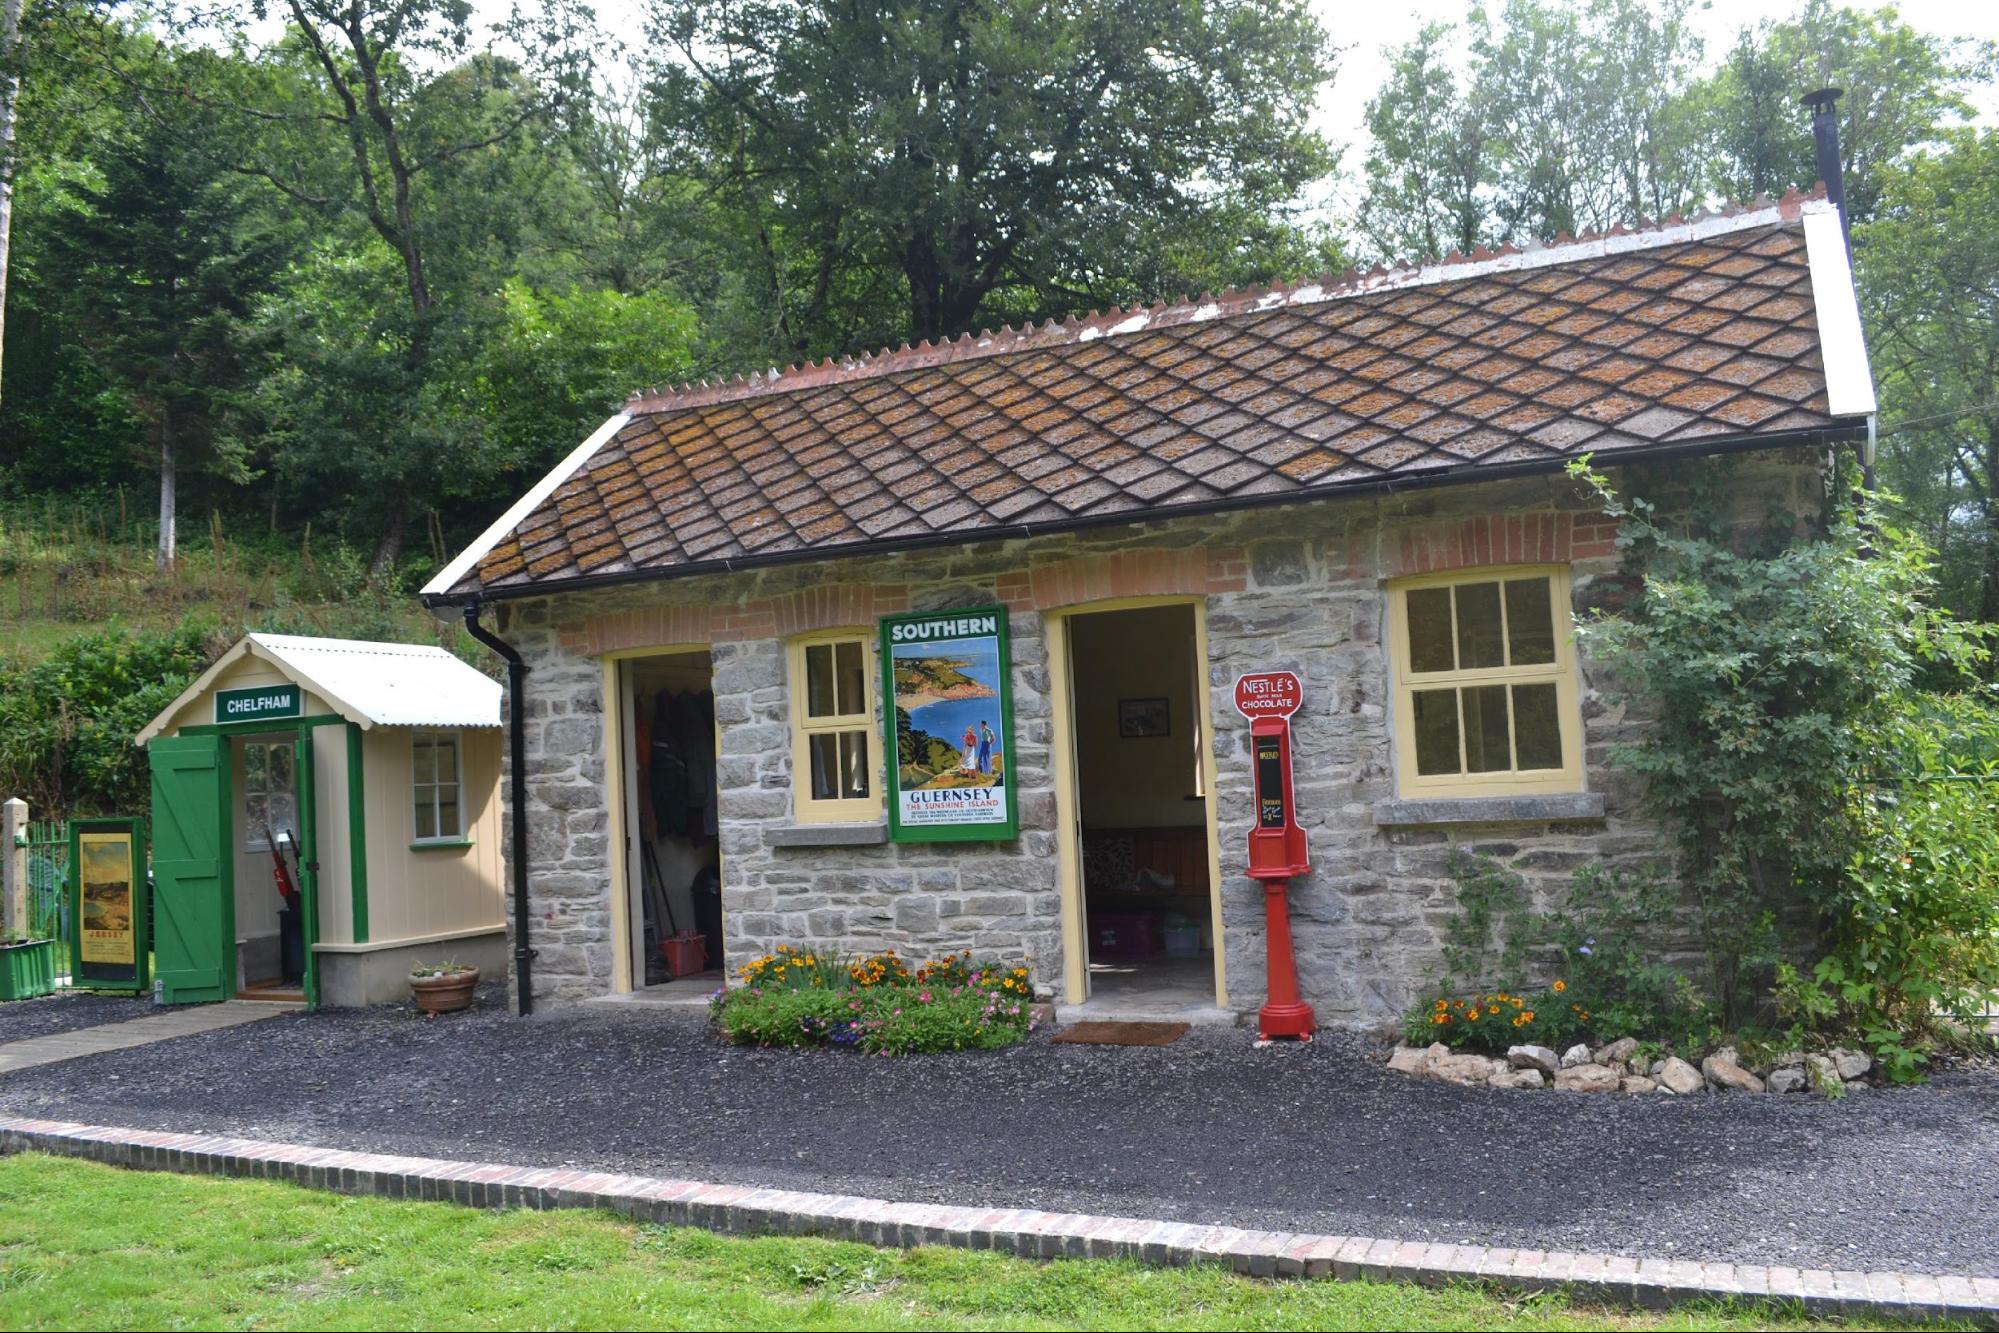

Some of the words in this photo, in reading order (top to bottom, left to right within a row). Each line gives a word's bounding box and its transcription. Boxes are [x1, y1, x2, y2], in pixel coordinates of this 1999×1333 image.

[892, 616, 996, 641] SOUTHERN
[227, 694, 291, 713] CHELFHAM
[1241, 698, 1293, 709] CHOCOLATE
[910, 788, 993, 804] GUERNSEY
[906, 803, 921, 811] THE
[925, 801, 965, 810] SUNSHINE
[968, 799, 999, 808] ISLAND
